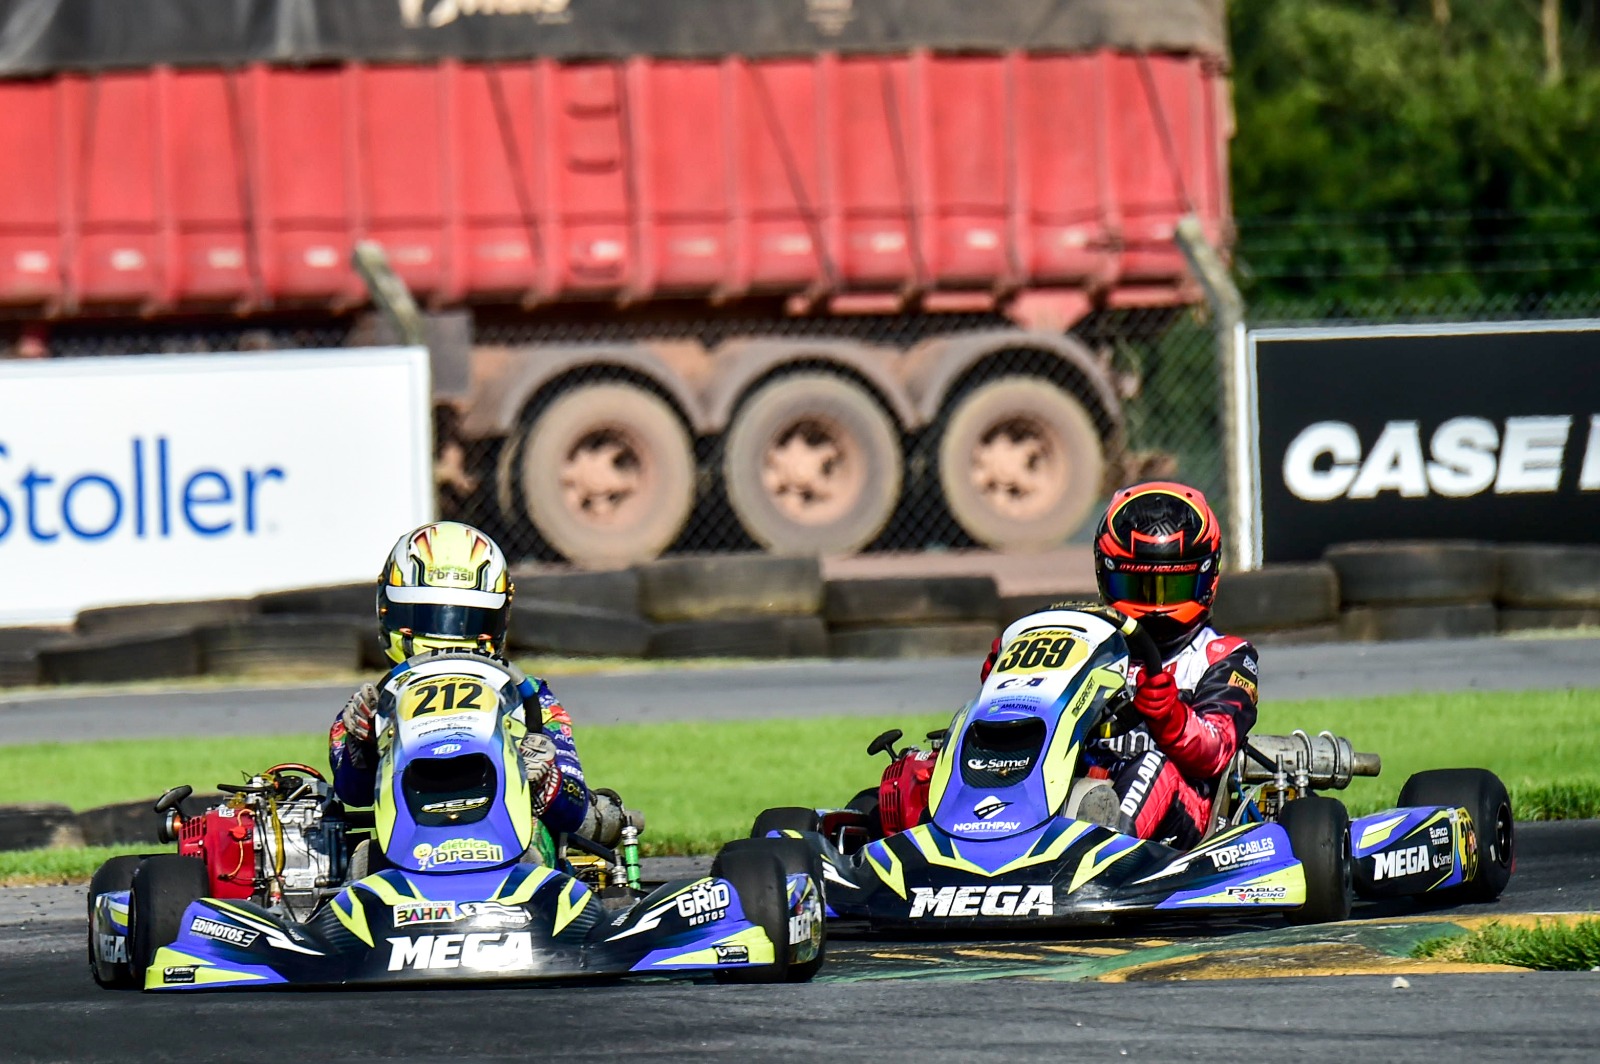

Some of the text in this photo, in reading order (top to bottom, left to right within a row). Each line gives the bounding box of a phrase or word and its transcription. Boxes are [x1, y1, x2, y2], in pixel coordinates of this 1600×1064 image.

[1283, 415, 1573, 501] CASE
[997, 637, 1076, 673] 369
[412, 683, 483, 718] 212
[987, 756, 1030, 768] Samel
[953, 821, 1021, 832] NORTHPAV
[436, 847, 501, 863] brasil
[1206, 837, 1274, 868] TOP CABLES
[1371, 845, 1431, 881] MEGA
[676, 883, 730, 917] GRID
[909, 885, 1053, 918] MEGA
[1227, 887, 1286, 896] PABLO
[397, 907, 452, 923] BAHIA
[689, 909, 725, 926] MOTOS
[385, 932, 534, 971] MEGA
